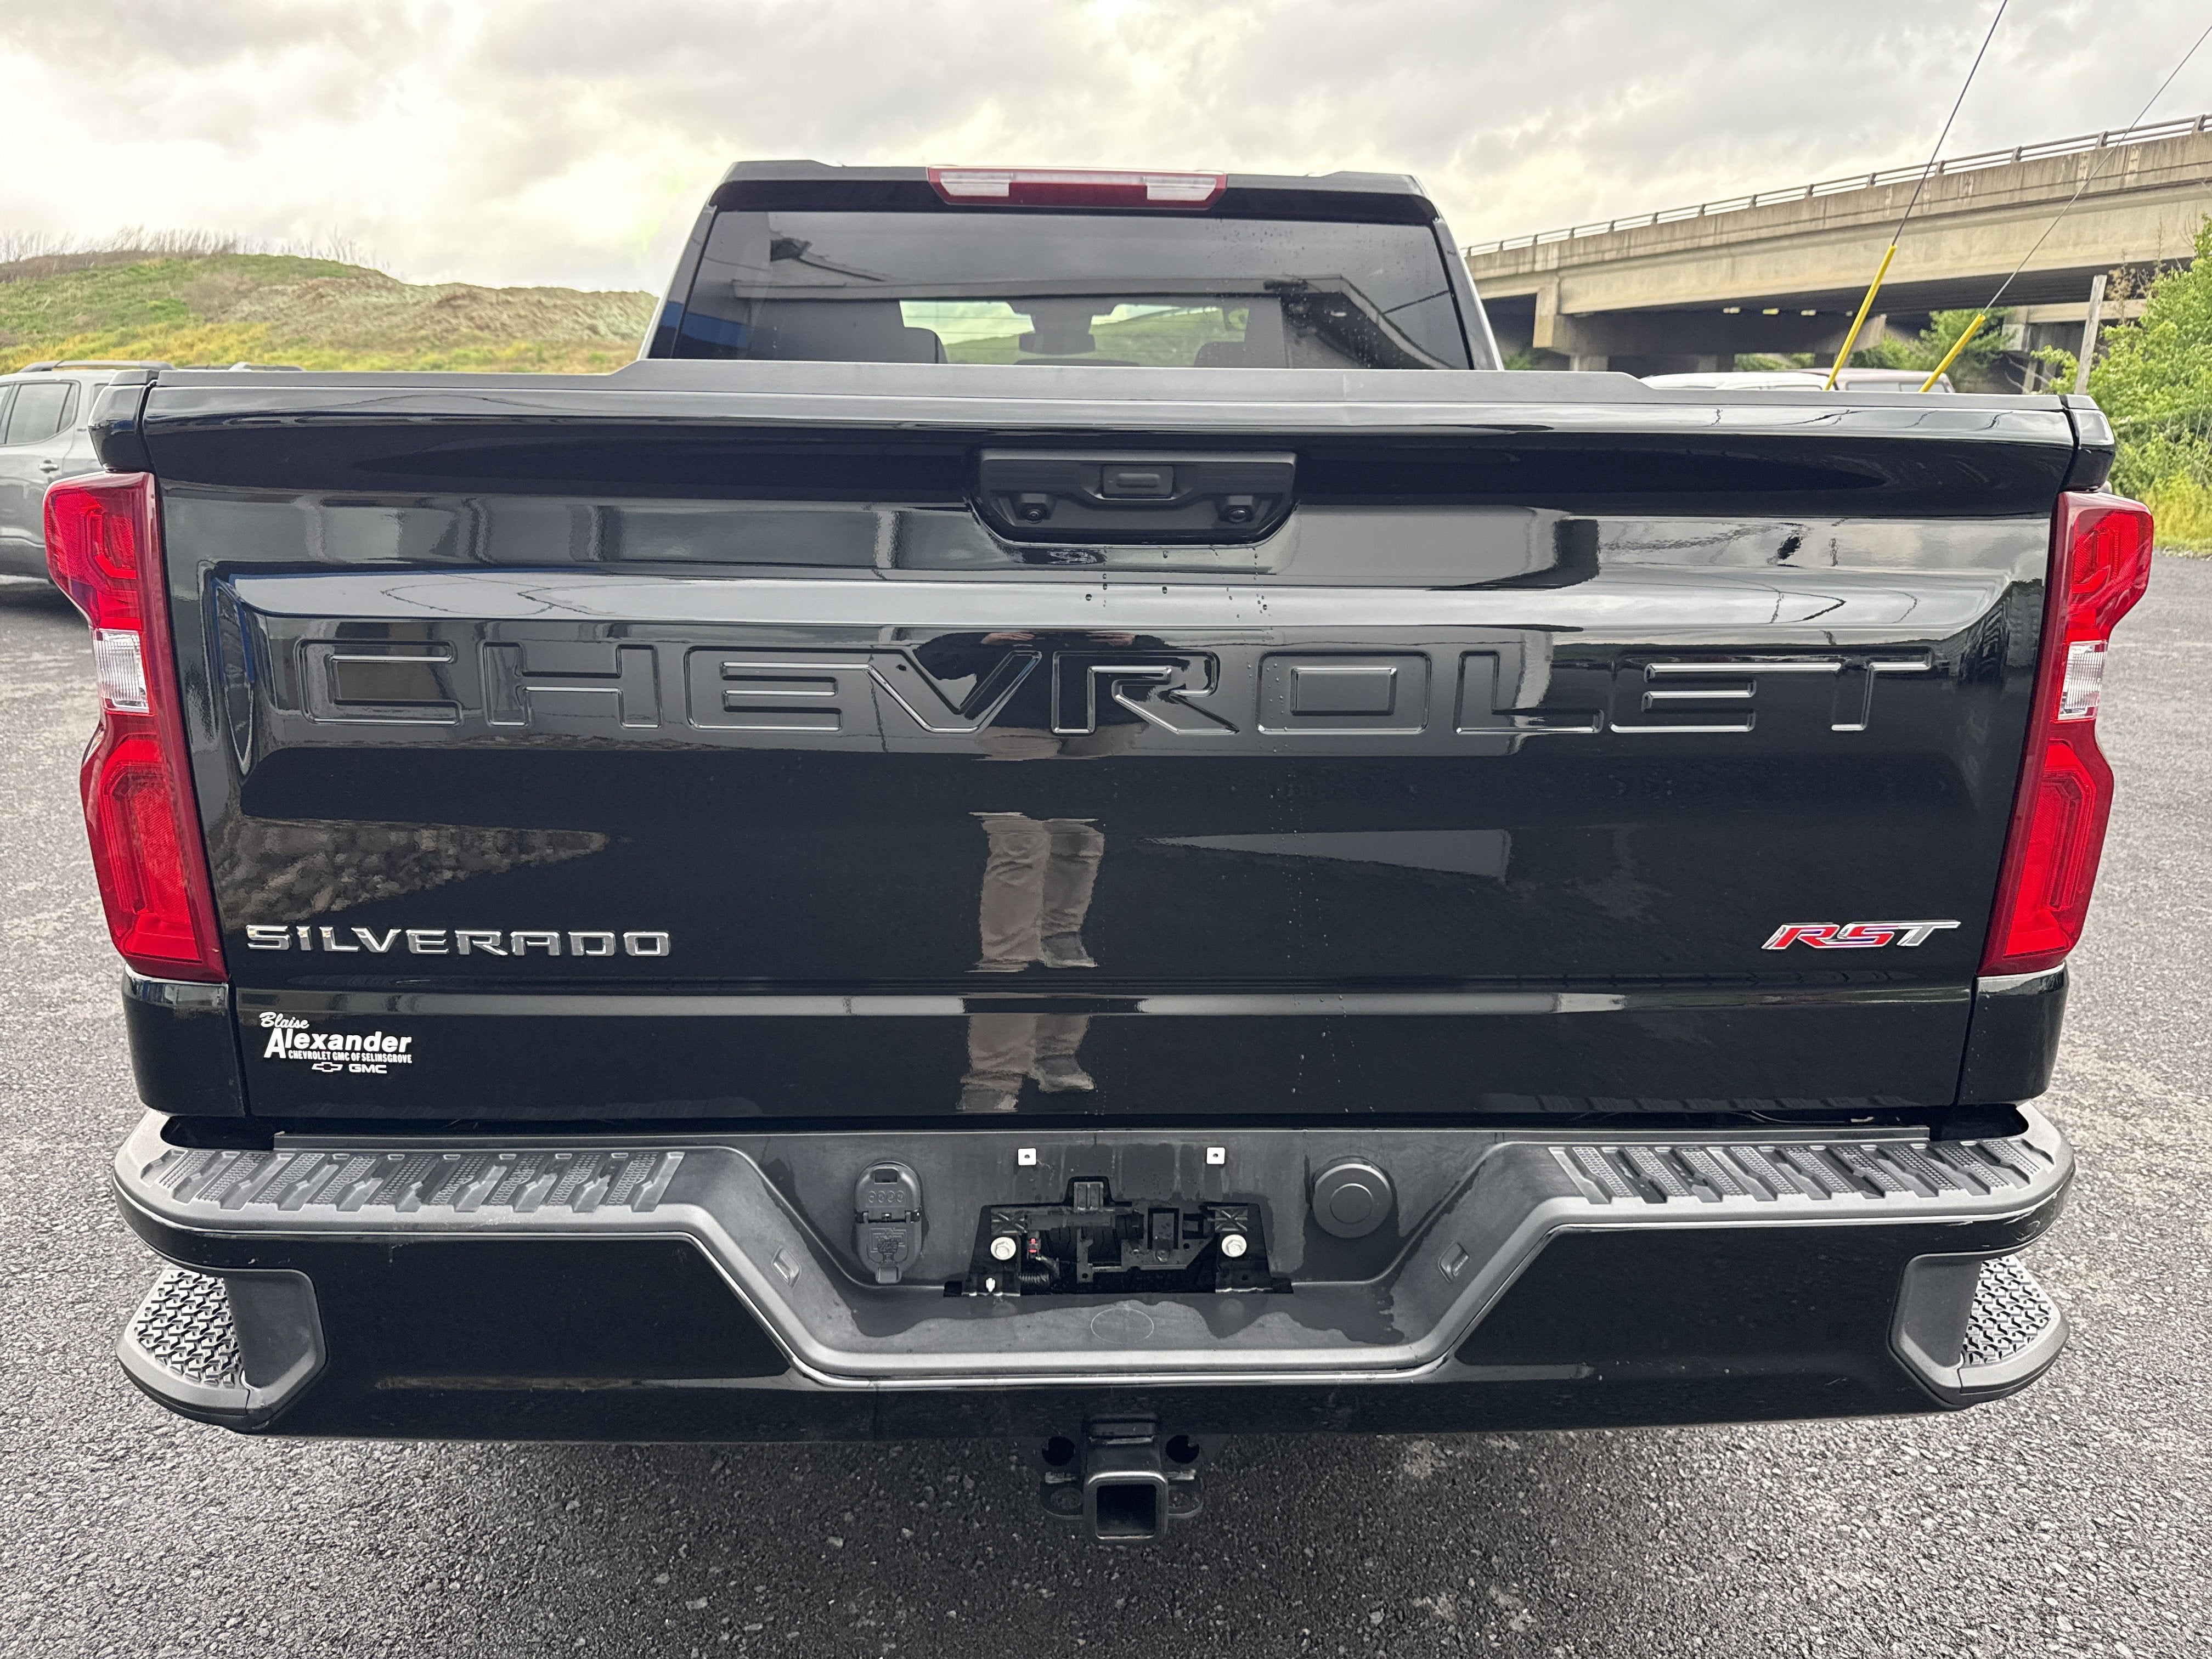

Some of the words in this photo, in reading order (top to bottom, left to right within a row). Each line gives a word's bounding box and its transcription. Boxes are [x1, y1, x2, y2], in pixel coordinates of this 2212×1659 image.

[294, 638, 1933, 737] CHEVROLET
[246, 924, 670, 957] SILVERADO
[1761, 919, 1962, 950] RST
[259, 1011, 309, 1029] Blaise
[263, 1028, 412, 1058] Alexander
[288, 1049, 331, 1060] CHEVROLET
[332, 1052, 350, 1062] GMC
[351, 1053, 361, 1062] OF
[362, 1054, 413, 1063] SELINSGROVE
[348, 1063, 387, 1073] GMC
